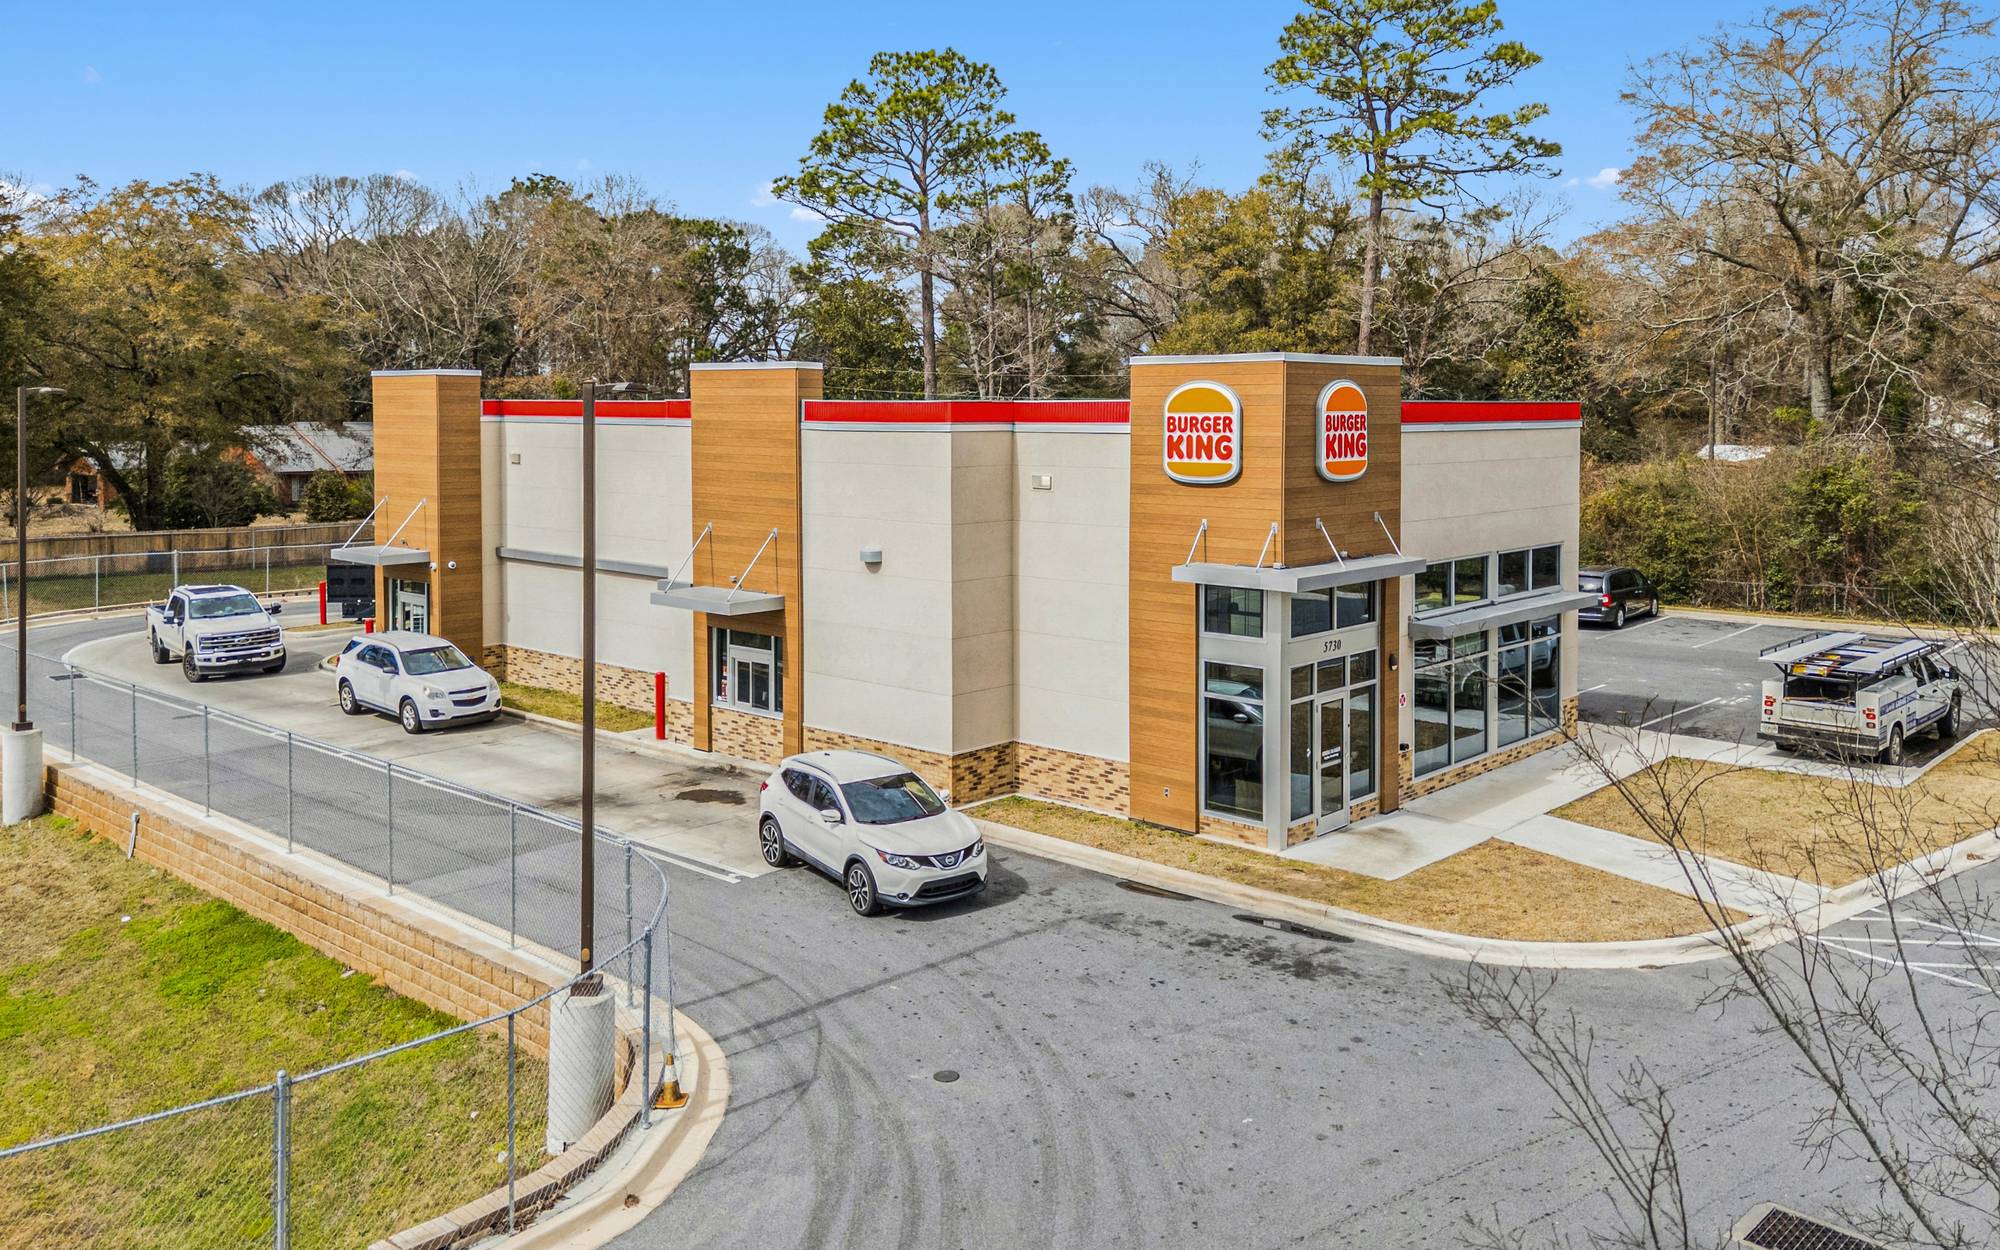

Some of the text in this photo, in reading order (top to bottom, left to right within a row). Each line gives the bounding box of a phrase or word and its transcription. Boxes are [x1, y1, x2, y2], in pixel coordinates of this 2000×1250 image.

[1166, 415, 1233, 433] BURGER
[1325, 414, 1366, 432] BURGER
[1166, 434, 1233, 460] KING
[1325, 432, 1366, 459] KING
[1323, 639, 1341, 653] 5730
